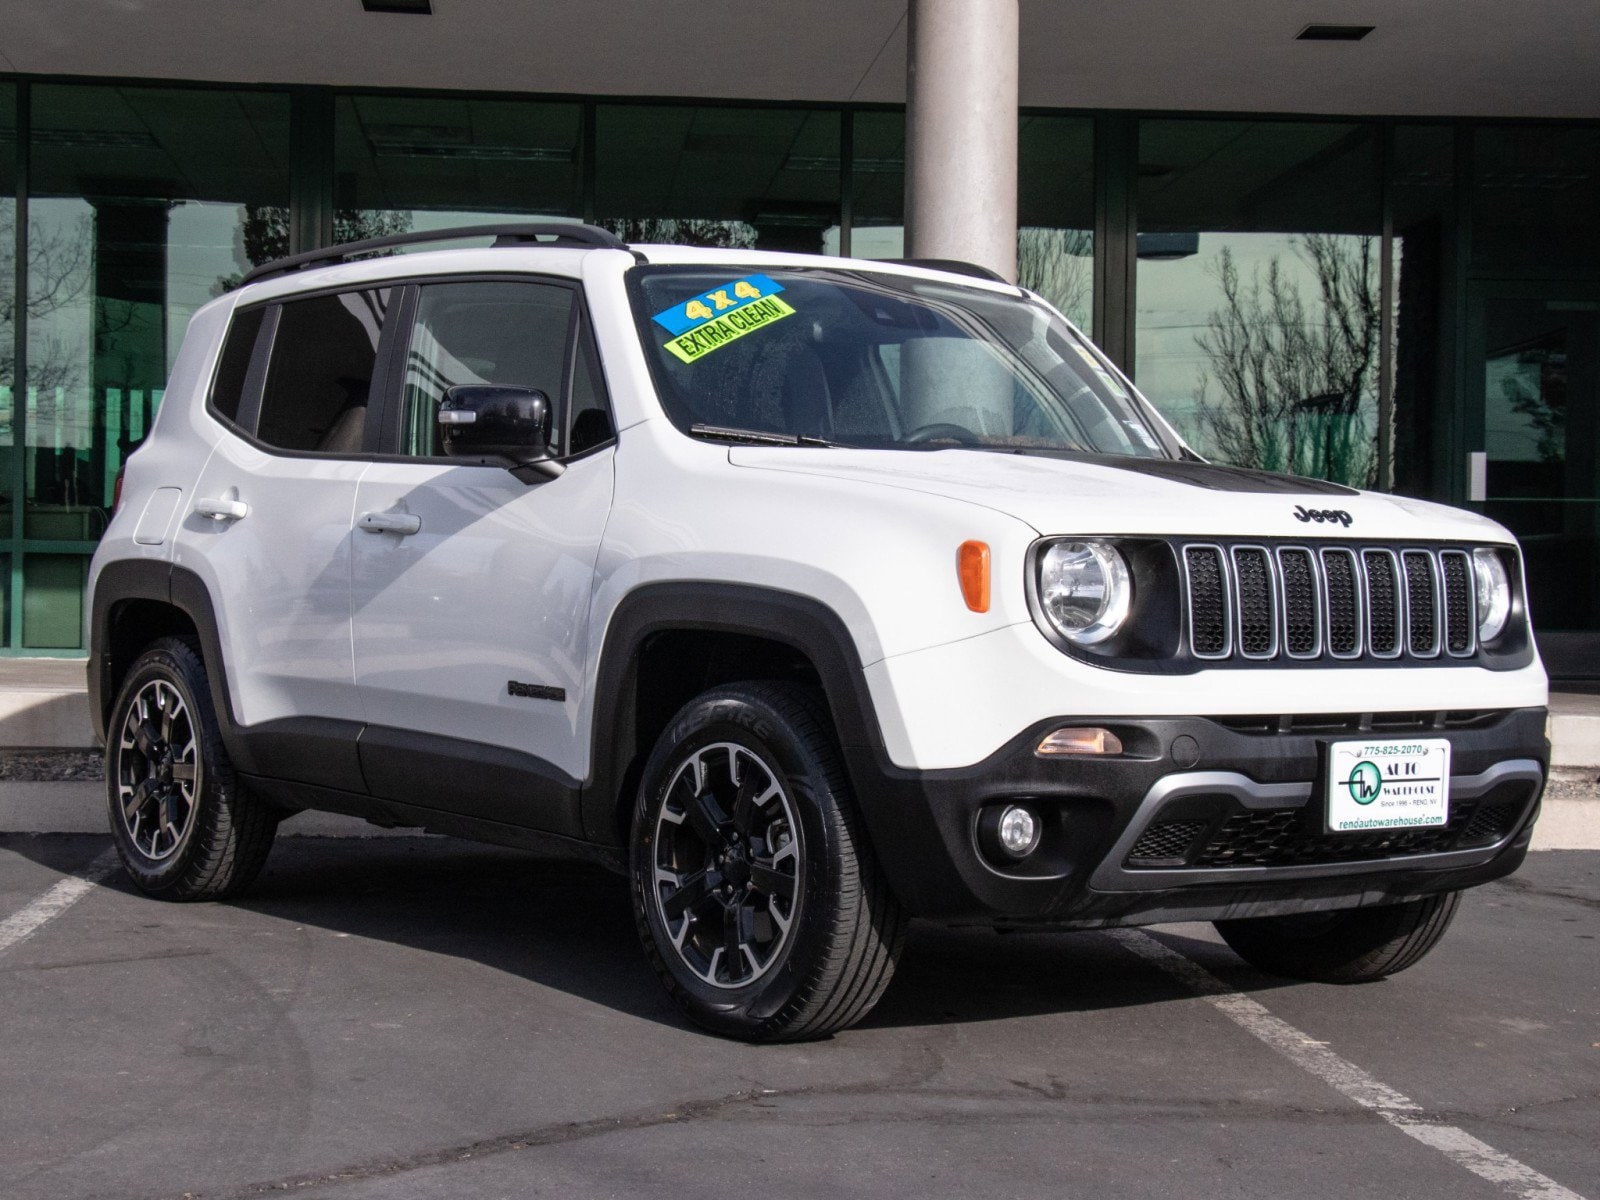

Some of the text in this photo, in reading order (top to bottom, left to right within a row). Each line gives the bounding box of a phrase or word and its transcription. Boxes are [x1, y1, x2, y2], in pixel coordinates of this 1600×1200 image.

[675, 298, 784, 357] EXTRA CLEAN
[1292, 504, 1354, 528] Jeep
[1364, 745, 1423, 755] 775-825-2070
[1385, 762, 1420, 776] AUTO
[1339, 816, 1443, 829] renoautowarehouse.com
